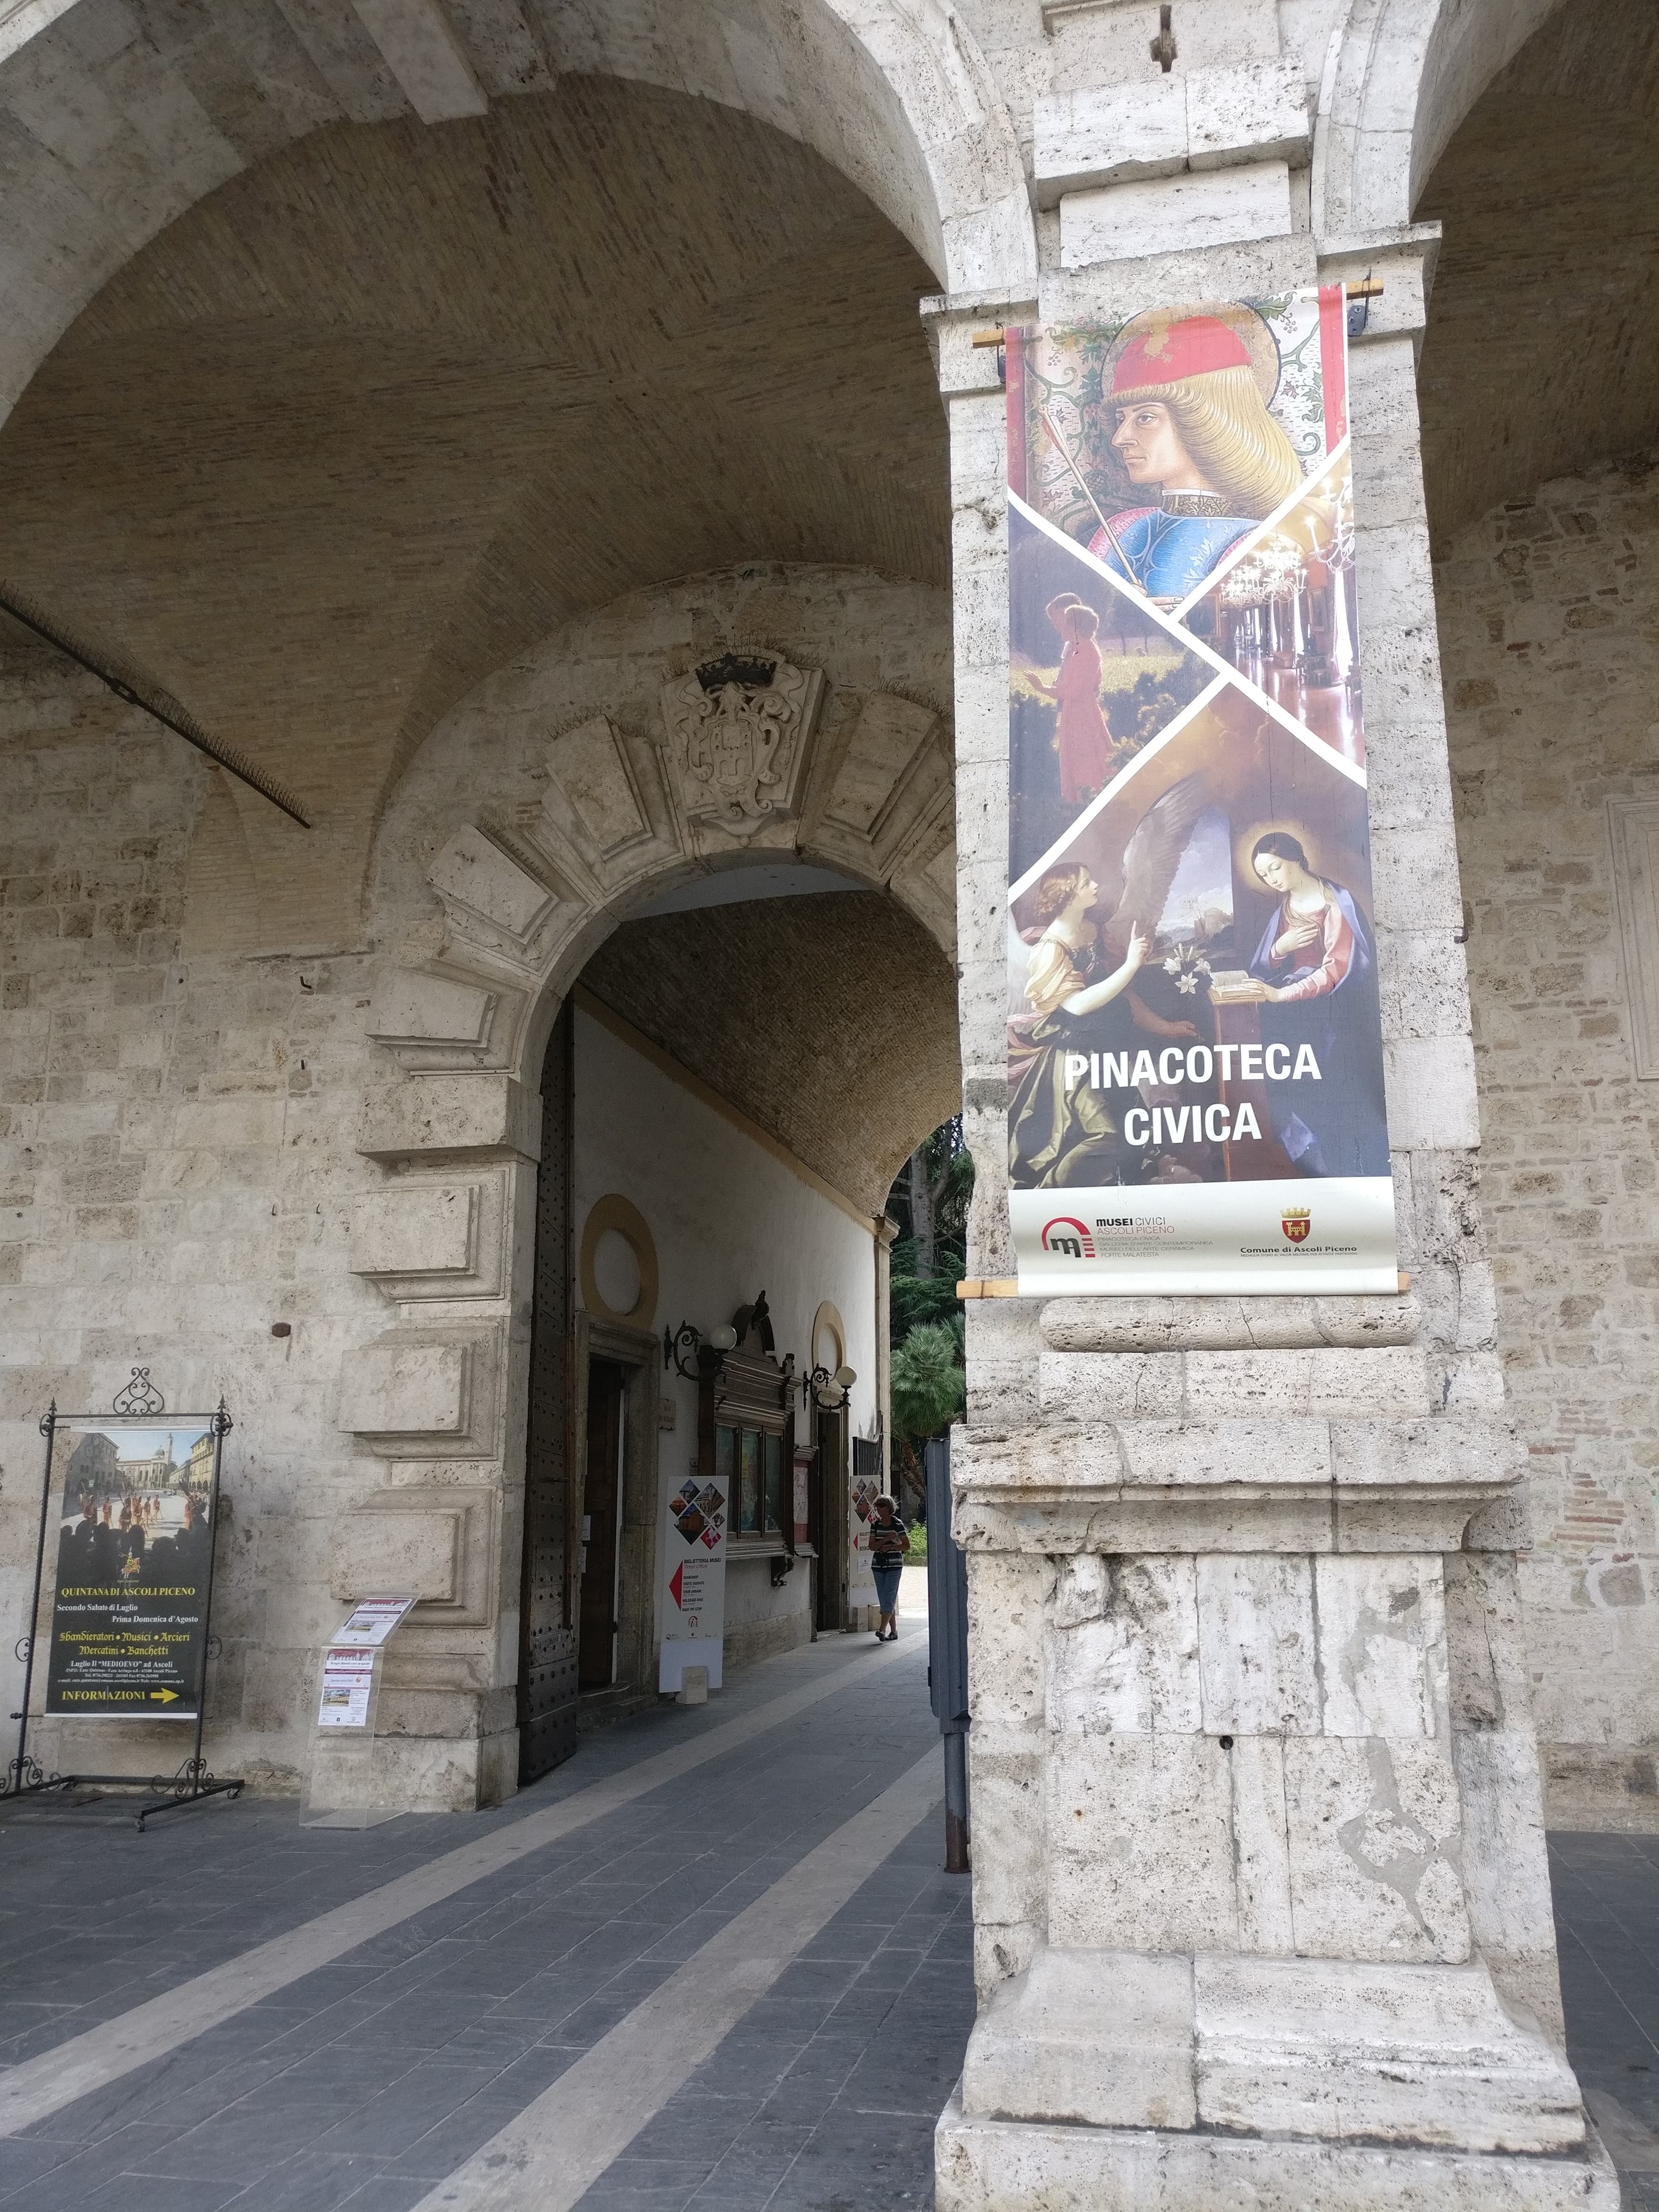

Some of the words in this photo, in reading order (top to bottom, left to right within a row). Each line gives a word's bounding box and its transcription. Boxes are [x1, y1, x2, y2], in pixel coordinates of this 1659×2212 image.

[1064, 1043, 1321, 1091] PINACOTECA
[1124, 1102, 1262, 1146] CIVICA
[1135, 1217, 1166, 1226] CIVICI
[1136, 1225, 1175, 1234] PICENO
[61, 1587, 109, 1597] QUINTANA
[122, 1587, 156, 1596] ASCOLI
[159, 1587, 195, 1596] PICENO
[59, 1631, 114, 1641] Sbandieratori
[122, 1632, 151, 1641] Musici
[160, 1631, 191, 1641] Arcieri
[79, 1645, 119, 1655] Mercatini
[127, 1645, 169, 1655] Banchetti
[62, 1691, 145, 1700] INFORMAZIONI
